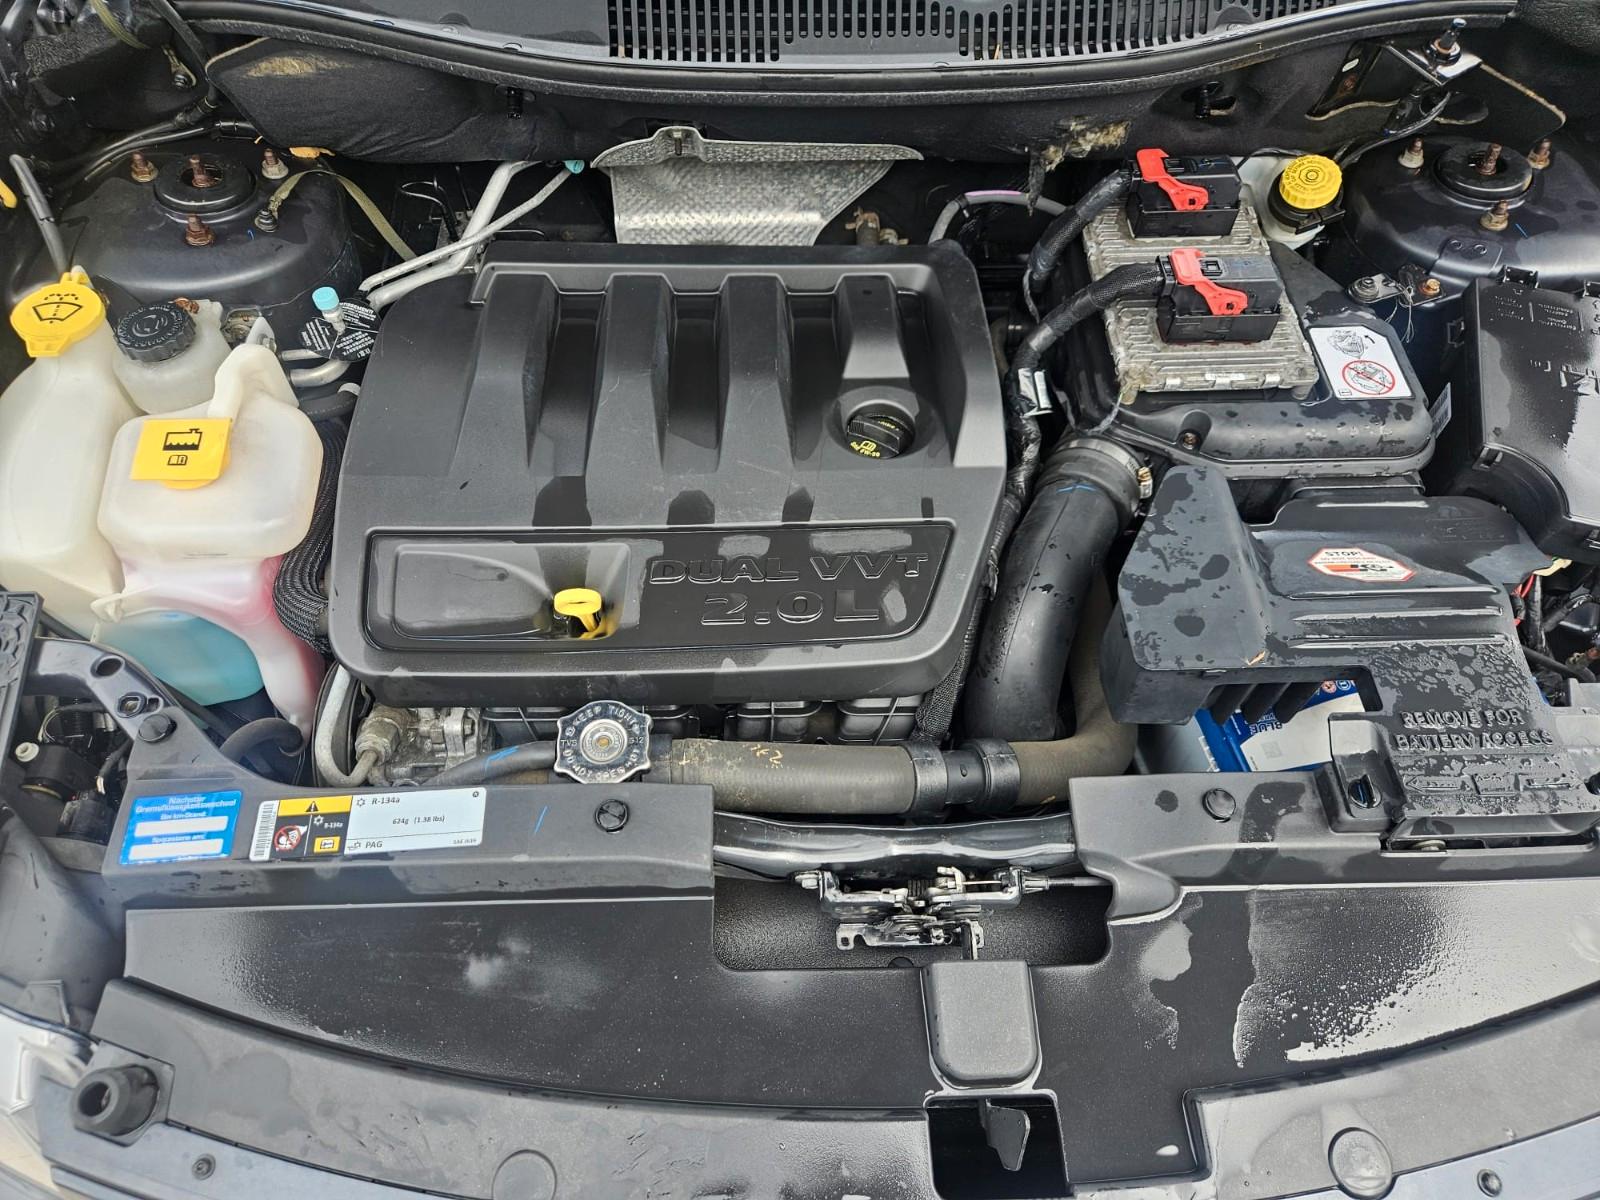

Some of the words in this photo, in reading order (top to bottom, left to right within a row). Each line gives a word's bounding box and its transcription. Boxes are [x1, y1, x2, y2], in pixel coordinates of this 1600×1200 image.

[649, 556, 799, 585] DUAL
[809, 552, 929, 581] VVT
[701, 590, 880, 625] 2.0L
[572, 705, 603, 727] KEEP
[607, 703, 638, 725] TIGHT
[1400, 708, 1483, 730] REMOVE
[1483, 707, 1527, 727] FOR
[1249, 720, 1284, 737] BLUE
[1395, 731, 1477, 751] BATTERY
[1479, 729, 1554, 751] ACCESS
[371, 796, 401, 805] R-134a
[392, 817, 410, 825] 624g
[365, 840, 383, 849] PAG
